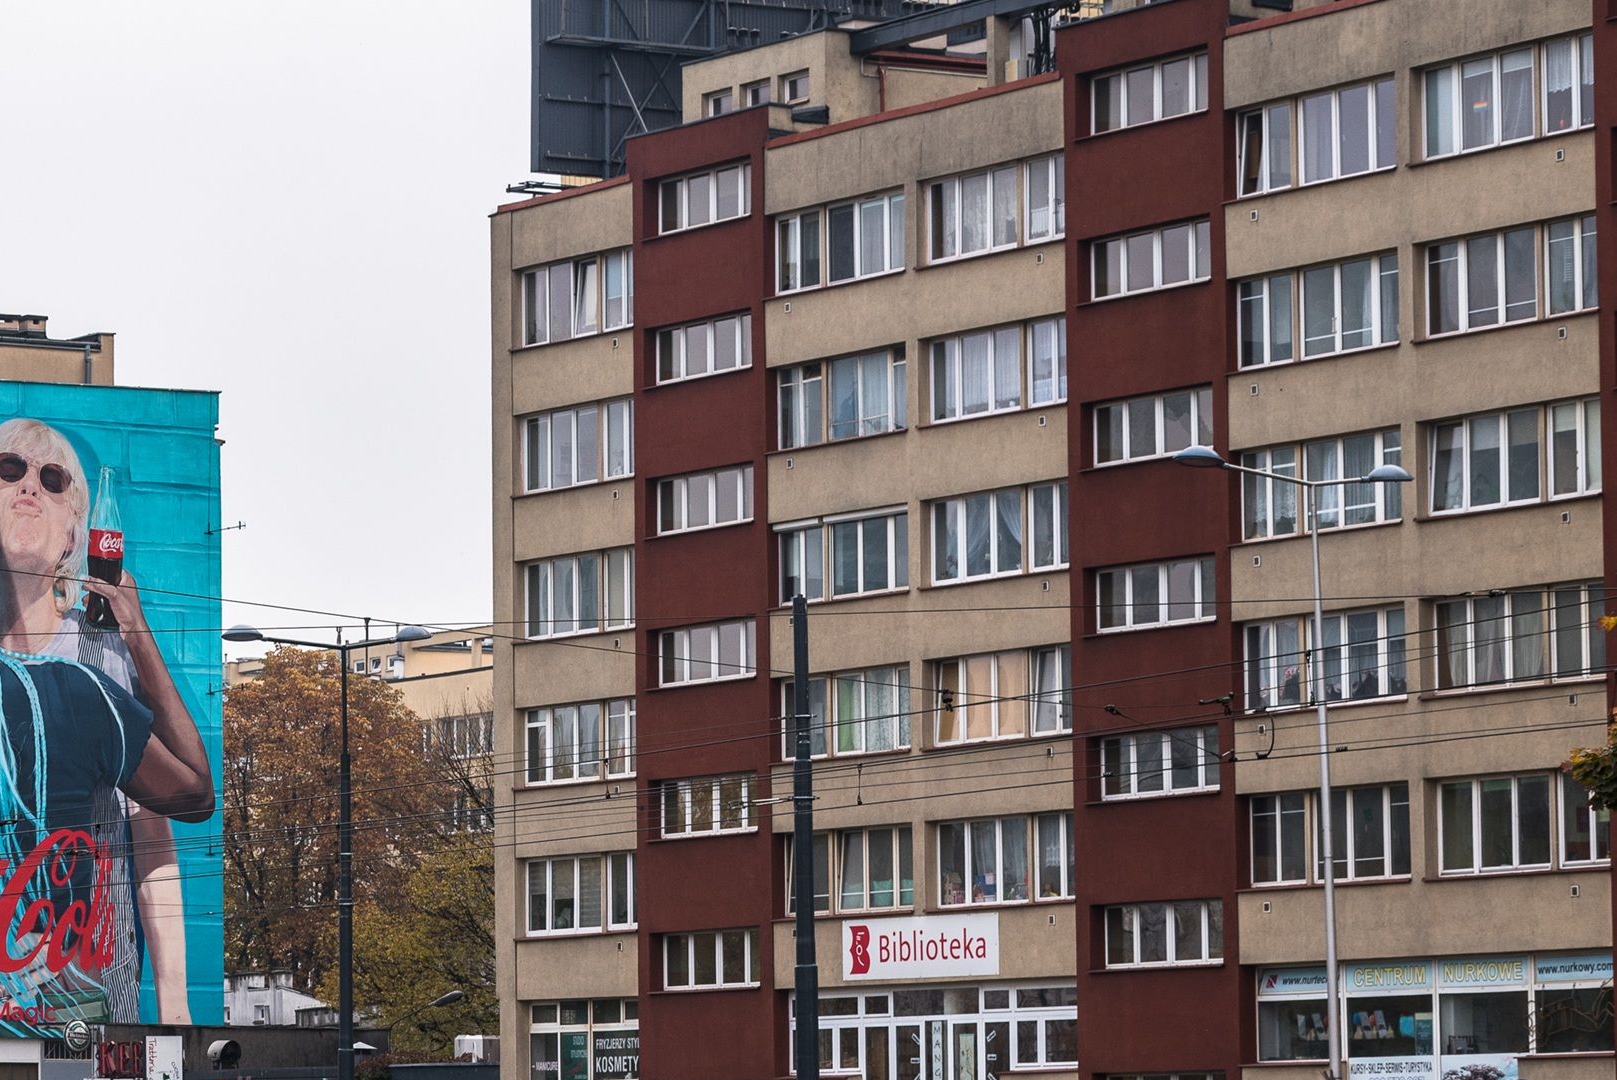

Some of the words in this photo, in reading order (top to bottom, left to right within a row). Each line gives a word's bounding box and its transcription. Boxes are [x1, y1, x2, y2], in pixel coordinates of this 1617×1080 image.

[879, 928, 987, 962] Biblioteka
[1354, 966, 1426, 987] CENTRUM
[1444, 961, 1523, 982] NURKOWE
[595, 1055, 639, 1072] KOSMETY
